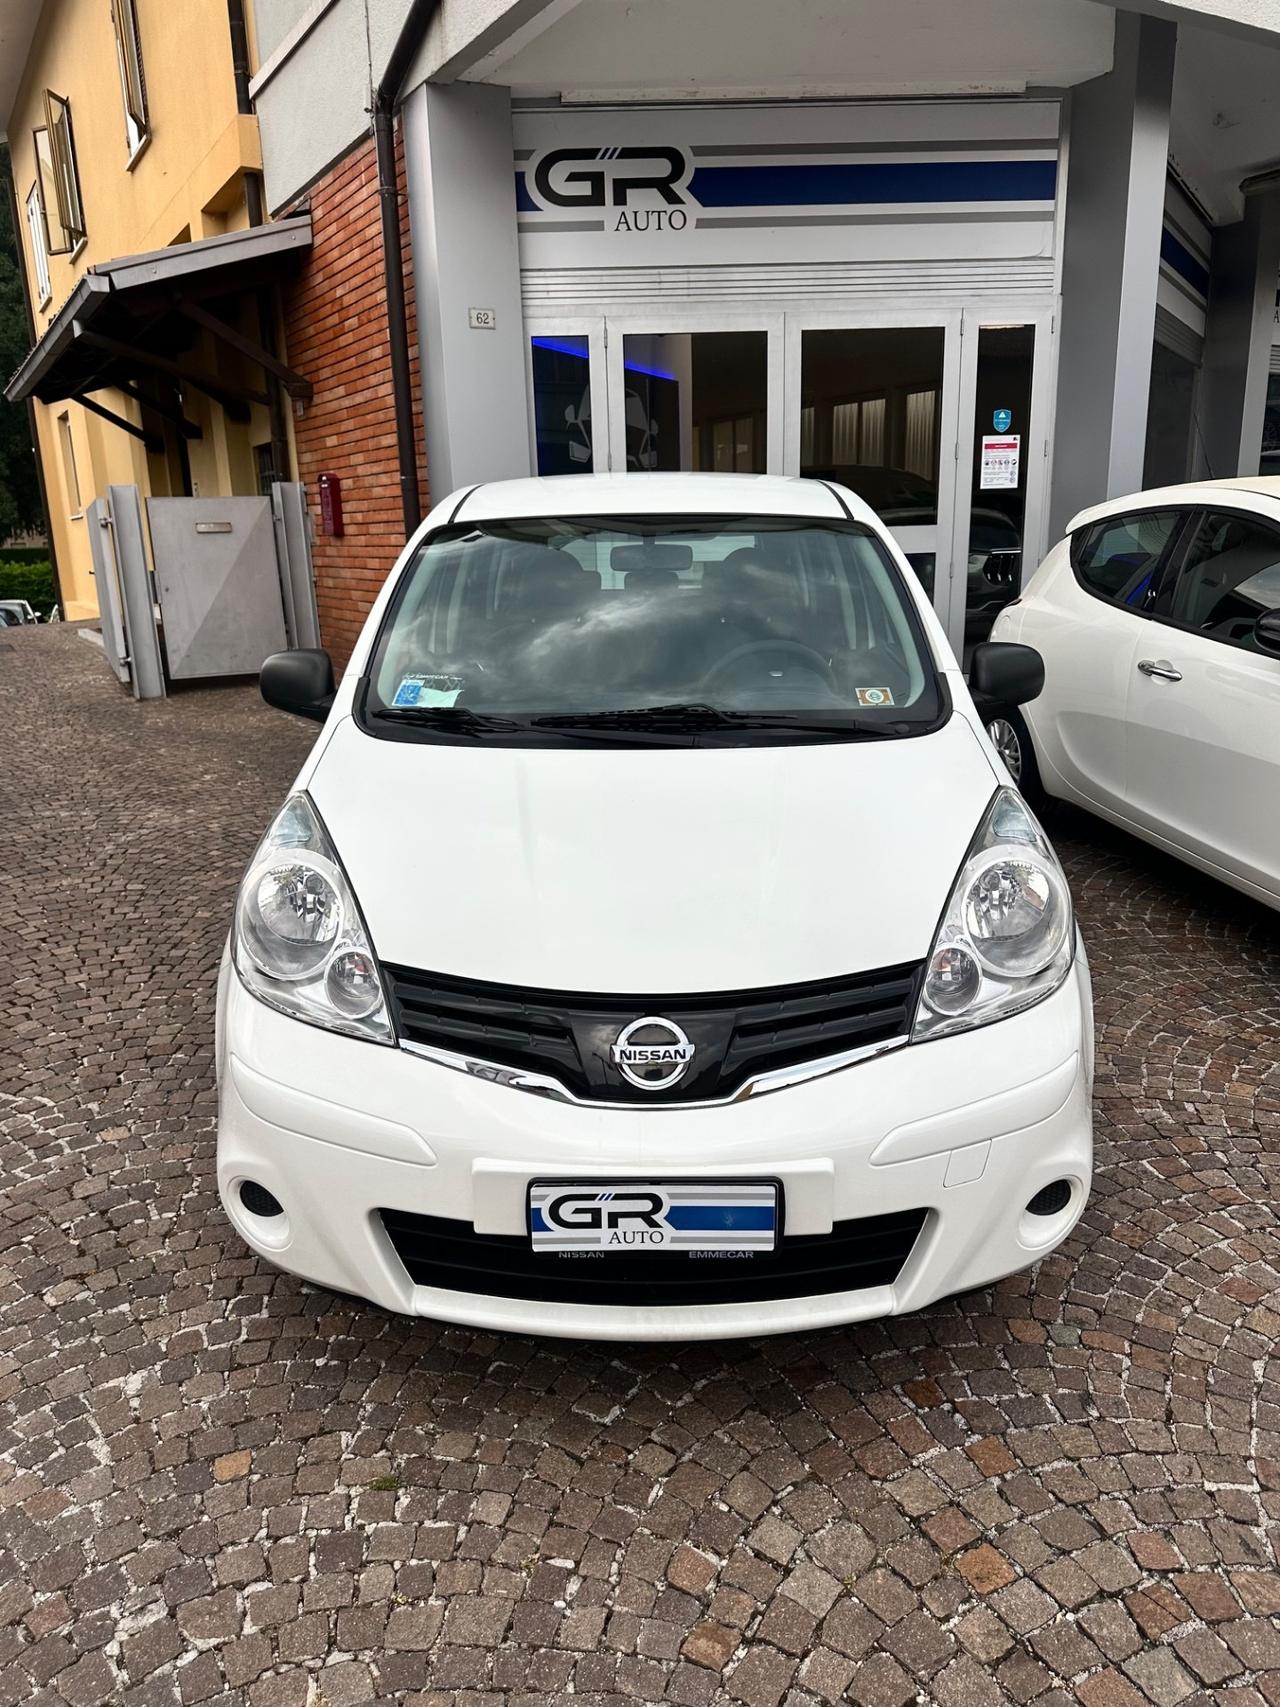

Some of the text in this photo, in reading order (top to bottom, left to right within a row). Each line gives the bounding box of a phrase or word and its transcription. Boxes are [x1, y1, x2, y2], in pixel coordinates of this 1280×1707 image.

[534, 146, 687, 207] GR
[614, 209, 687, 231] AUTO
[476, 312, 489, 324] 62
[620, 1048, 686, 1061] NISSAN
[548, 1192, 664, 1229] GR
[608, 1230, 664, 1244] AUTO
[558, 1251, 754, 1259] NISSAN EMMECAR
